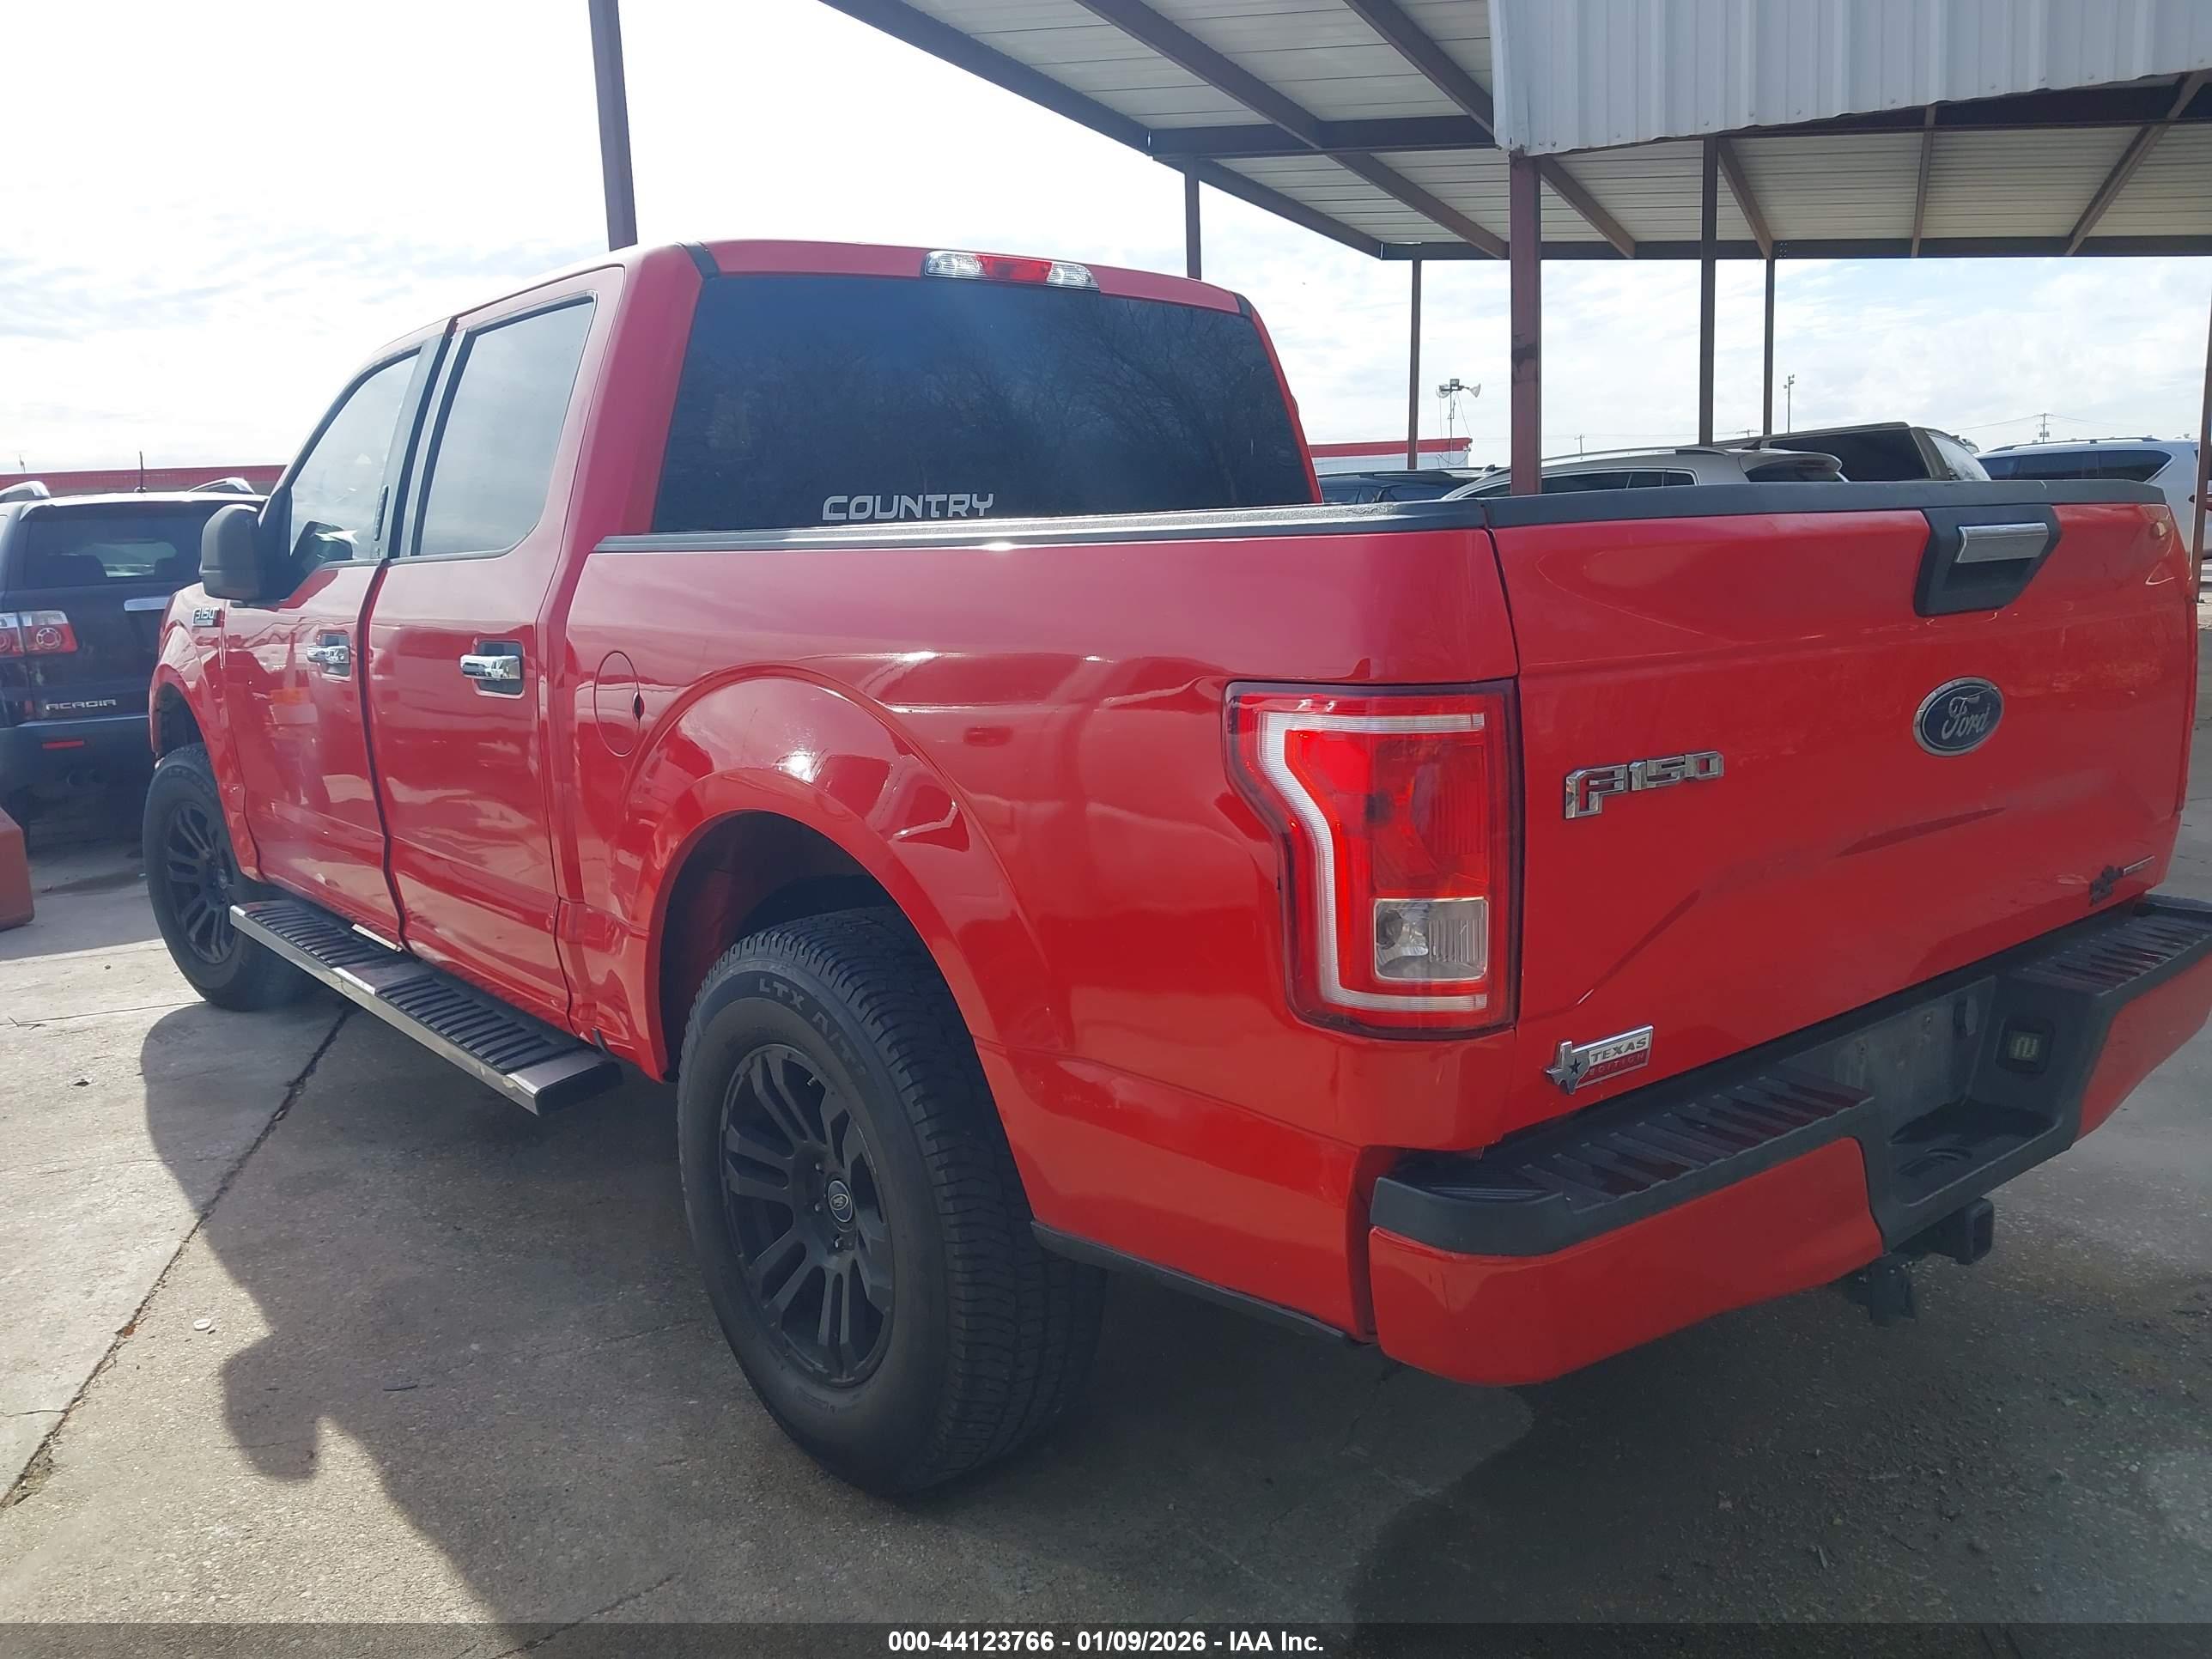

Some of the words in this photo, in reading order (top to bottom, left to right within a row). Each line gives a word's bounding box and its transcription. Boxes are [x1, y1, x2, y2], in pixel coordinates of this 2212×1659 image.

[822, 493, 994, 520] COUNTRY
[46, 699, 118, 711] ACADIA
[1941, 694, 1991, 740] Ford
[758, 977, 805, 1011] LTX
[1590, 1037, 1647, 1062] TEXAS
